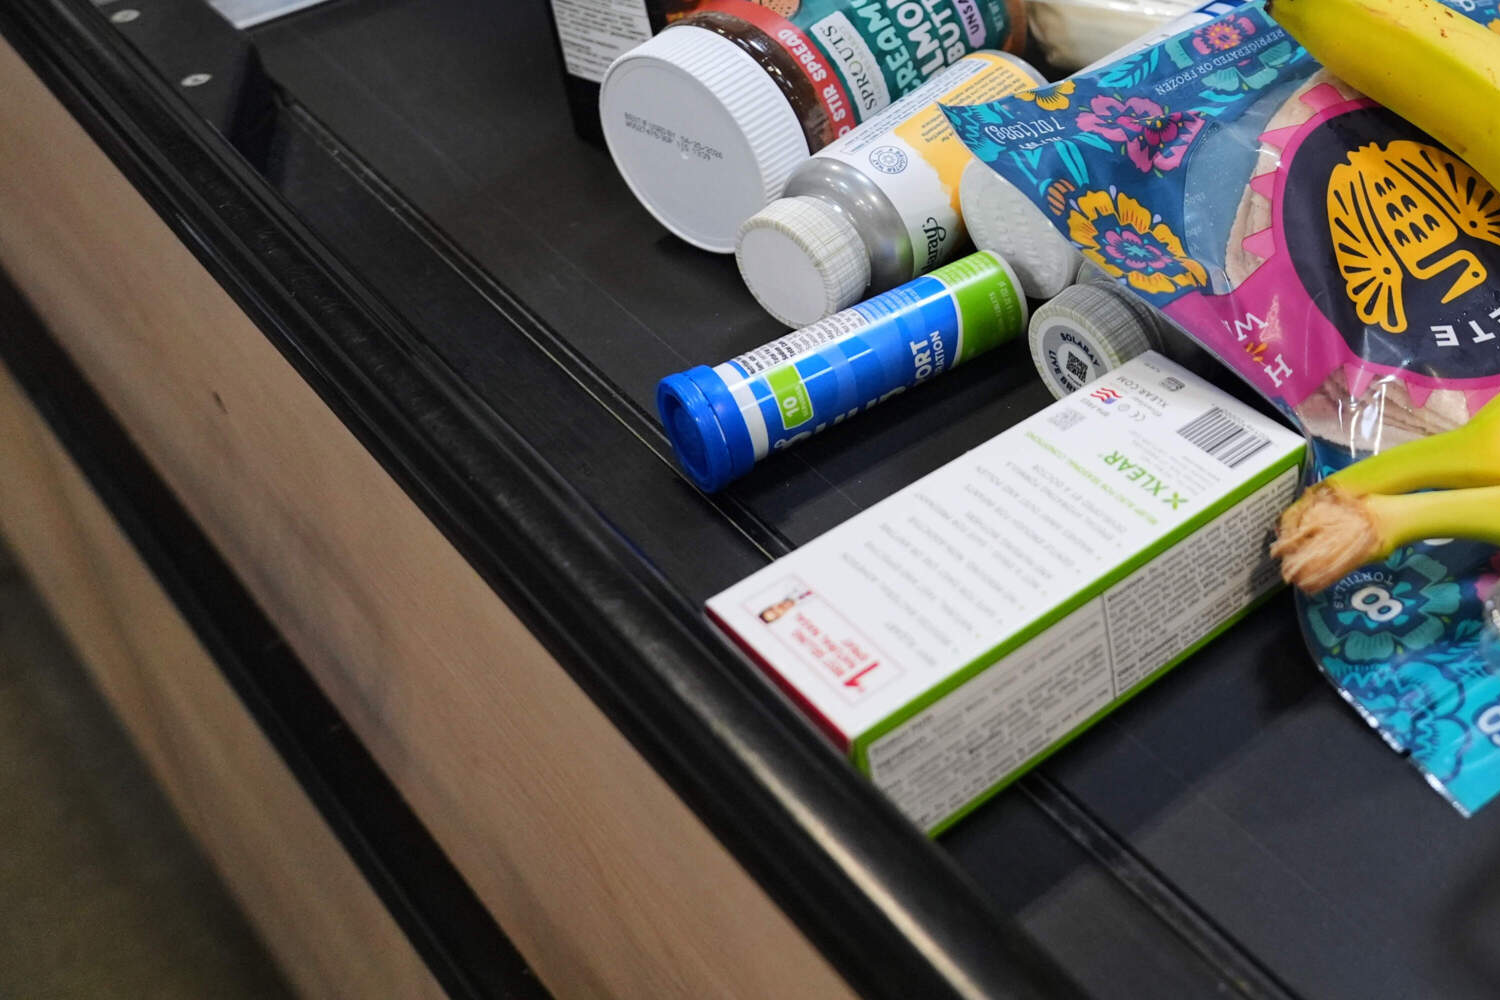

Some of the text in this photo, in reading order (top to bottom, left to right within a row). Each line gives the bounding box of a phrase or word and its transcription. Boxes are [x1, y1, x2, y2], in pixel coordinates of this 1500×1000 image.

[776, 28, 847, 121] STIR SPREAD
[820, 22, 878, 112] SPROUTS
[1153, 27, 1283, 94] REFRIGERATED OR FROZEN
[982, 116, 1068, 145] 7 OZ (198g)
[1048, 349, 1062, 374] LIVE
[1059, 332, 1101, 366] SOLARAY
[781, 398, 800, 418] 10
[1116, 374, 1170, 408] XLEAR.COM
[1104, 448, 1166, 494] XLEAR
[1351, 585, 1405, 623] 8
[789, 626, 846, 680] BEST SELLING
